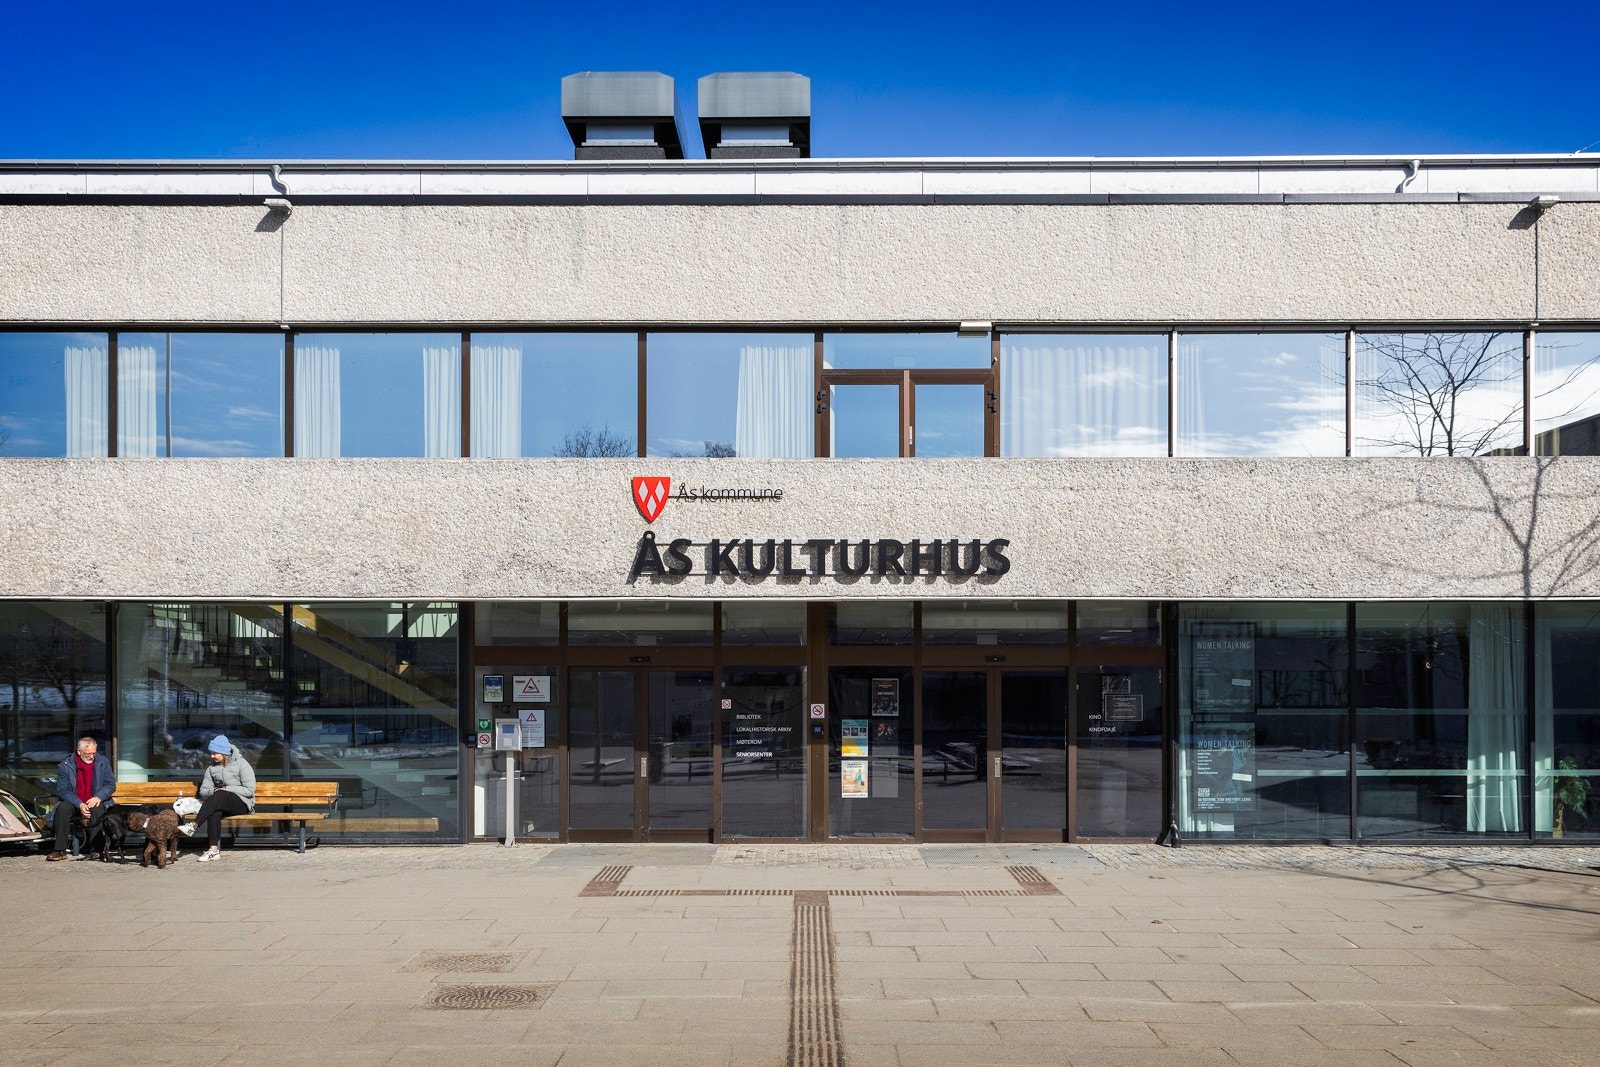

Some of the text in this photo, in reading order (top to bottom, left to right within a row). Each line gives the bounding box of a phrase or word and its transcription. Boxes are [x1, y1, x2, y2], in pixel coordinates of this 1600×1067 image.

[679, 482, 783, 498] Ås kommune
[632, 530, 1011, 577] ÅS KULTURHUS
[1197, 641, 1251, 650] WOMEN TALKING
[1197, 740, 1252, 748] WOMEN TALKING
